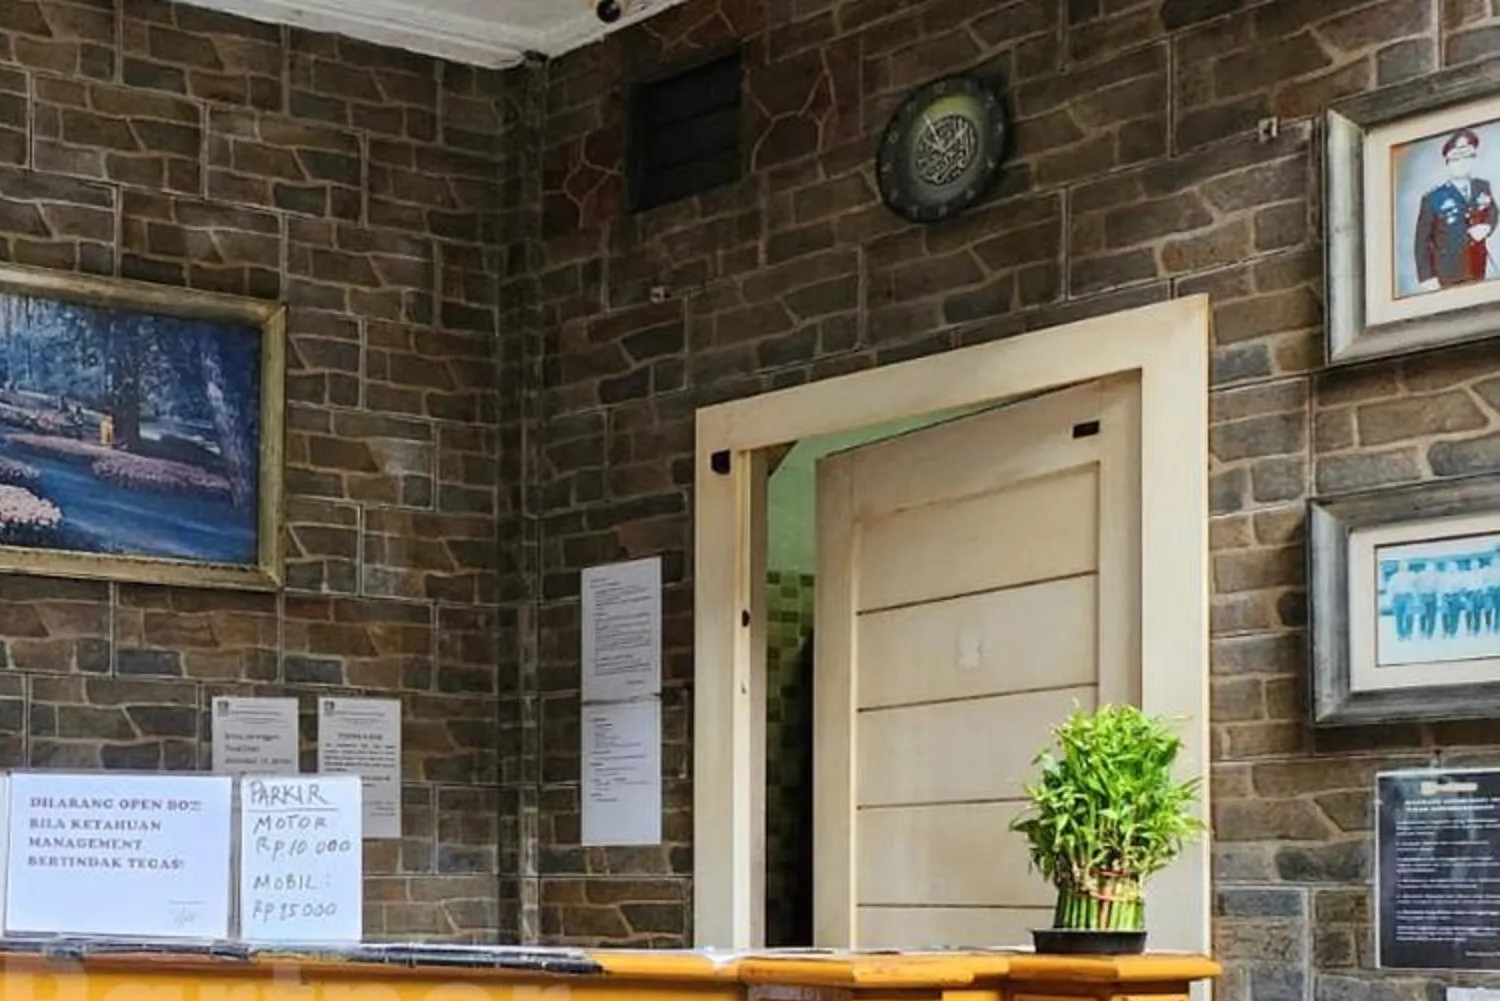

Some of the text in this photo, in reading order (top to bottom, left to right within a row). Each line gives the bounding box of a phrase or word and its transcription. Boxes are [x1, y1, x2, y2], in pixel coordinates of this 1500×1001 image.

[250, 780, 330, 806] PARKIR
[29, 797, 113, 809] DILARANG
[119, 798, 162, 810] OPEN
[29, 818, 161, 831] BILA KETAHUAN
[29, 837, 142, 849] MANAGEMENT
[28, 856, 122, 869] BERTINDAK
